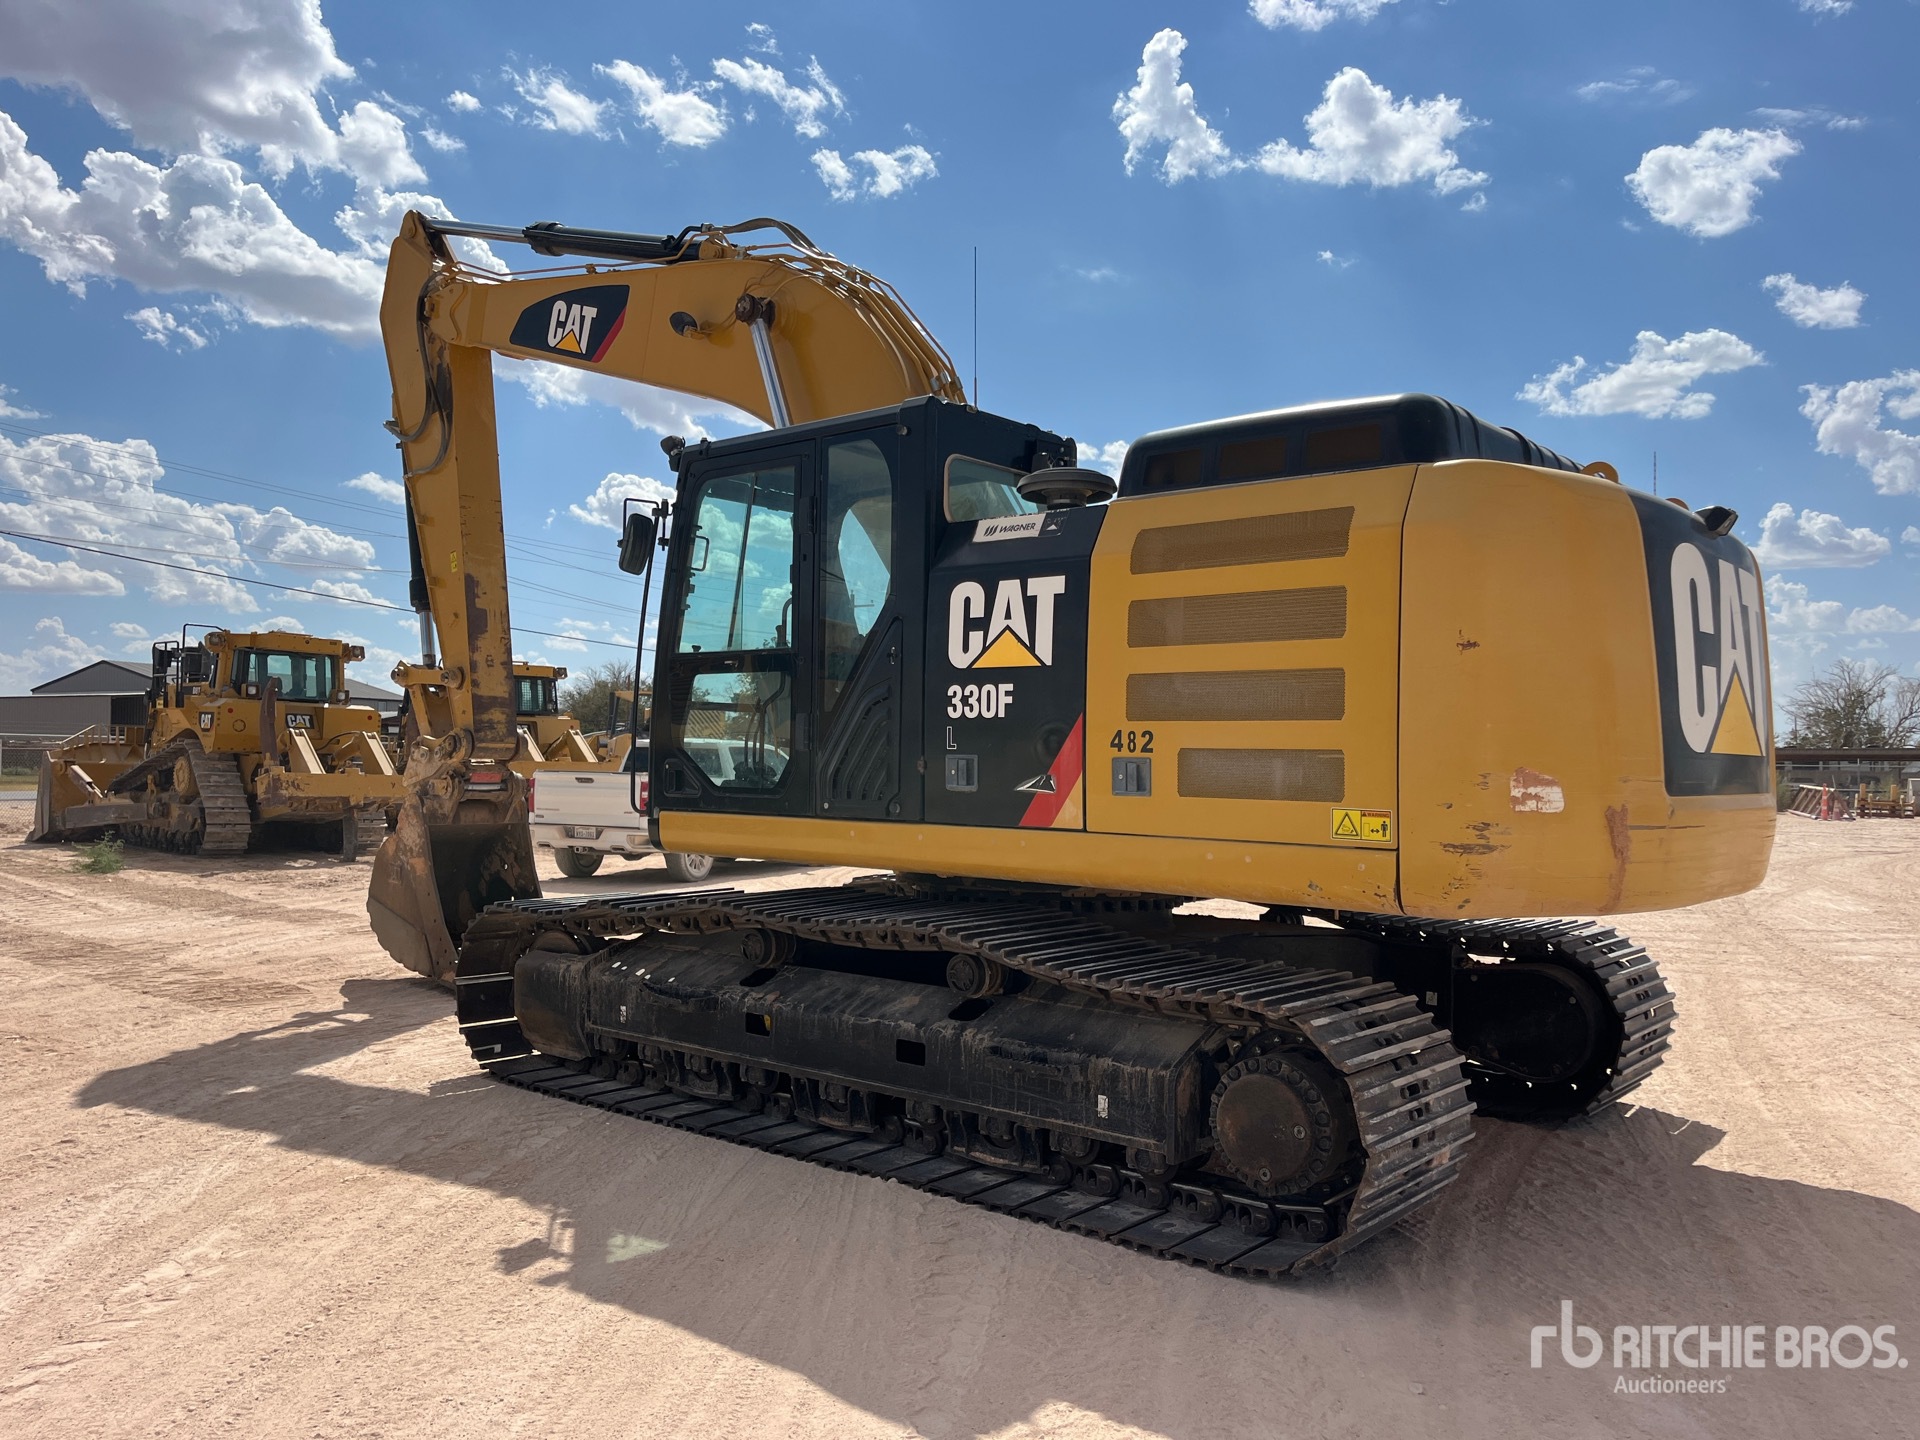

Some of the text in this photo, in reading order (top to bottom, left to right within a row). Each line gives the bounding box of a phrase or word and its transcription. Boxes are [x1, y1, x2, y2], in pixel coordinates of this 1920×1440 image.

[547, 300, 598, 354] CAT
[999, 522, 1036, 533] WAGNER
[948, 575, 1066, 669] CAT
[1670, 542, 1766, 757] CAT
[947, 683, 1014, 719] 330F
[200, 713, 212, 729] CAT
[286, 714, 311, 728] CAT
[946, 726, 957, 750] L
[1110, 729, 1154, 753] 482
